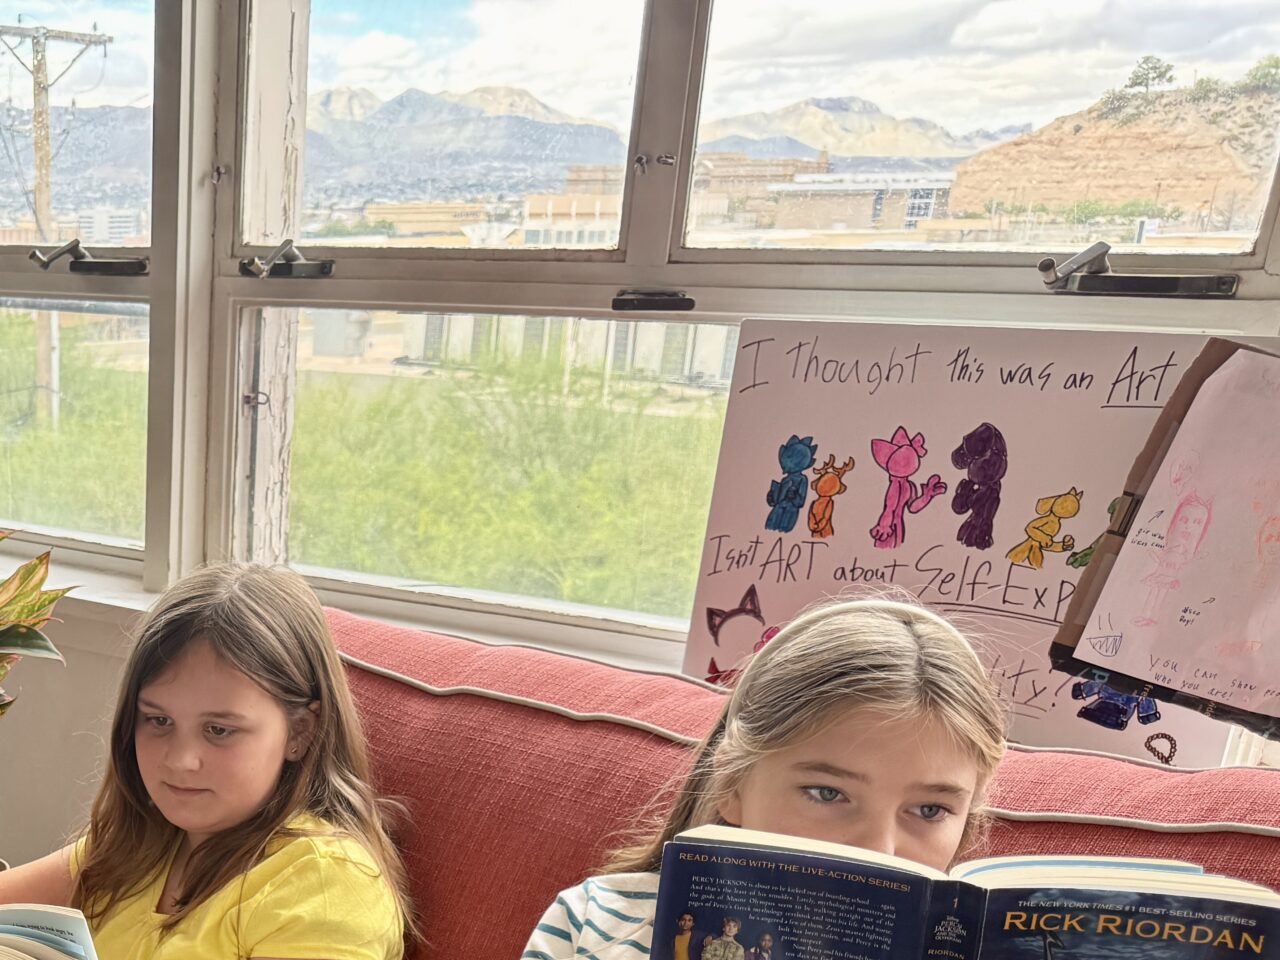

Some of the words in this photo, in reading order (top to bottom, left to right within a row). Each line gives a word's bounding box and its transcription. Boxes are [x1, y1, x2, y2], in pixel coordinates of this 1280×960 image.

[739, 338, 775, 393] I
[946, 346, 984, 383] this
[1000, 362, 1054, 391] was
[1063, 372, 1093, 390] an
[1106, 346, 1178, 404] Art
[707, 535, 763, 576] Isn't
[759, 537, 828, 583] ART
[833, 557, 908, 583] about
[679, 852, 709, 862] READ
[711, 855, 747, 867] ALONG
[749, 859, 776, 870] WITH
[778, 862, 800, 873] THE
[802, 865, 866, 884] LIVE-ACTION
[692, 875, 714, 883] PERCY
[716, 878, 747, 886] JACKSON
[1063, 901, 1090, 909] YORK
[1092, 902, 1123, 911] TIMES
[1138, 906, 1214, 920] BEST-SELLING
[1215, 914, 1257, 926] SERIES
[1003, 911, 1085, 933] RICK
[1096, 914, 1265, 954] RIORDAN
[928, 949, 964, 960] RIORDAN
